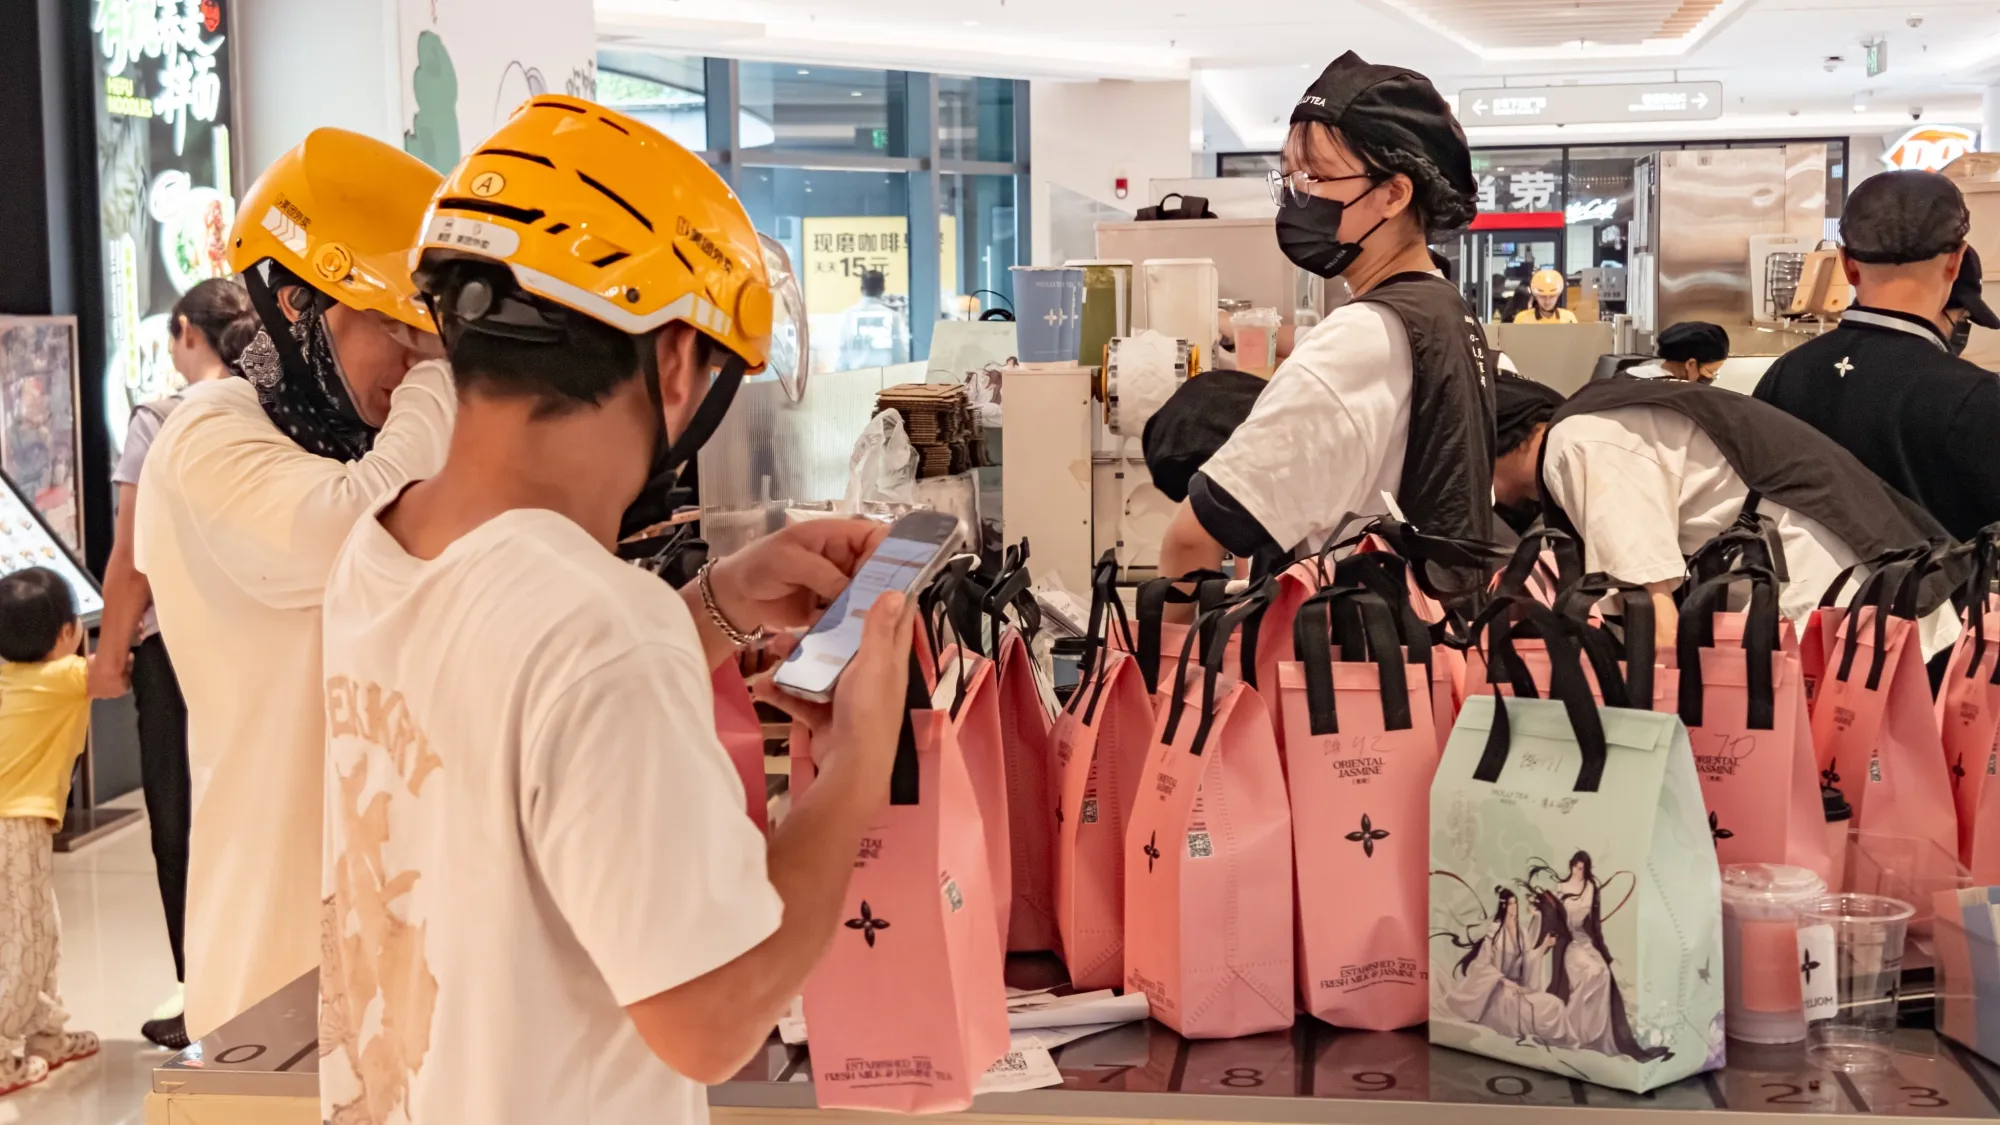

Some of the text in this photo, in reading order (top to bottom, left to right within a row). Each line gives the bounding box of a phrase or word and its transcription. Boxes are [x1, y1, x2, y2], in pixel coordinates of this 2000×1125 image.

[106, 77, 134, 97] HEFU
[106, 95, 153, 118] NOODLES
[1310, 96, 1326, 106] TEA
[476, 176, 494, 193] A
[813, 232, 944, 254] 现磨咖啡
[1333, 757, 1386, 770] ORIENTAL
[1339, 765, 1383, 778] JASMINE
[1694, 755, 1741, 767] RIENTAL
[1320, 978, 1349, 989] FRESH
[1380, 967, 1416, 979] JASMINE
[1094, 1063, 1137, 1084] 7
[1219, 1067, 1265, 1088] 8
[1351, 1071, 1397, 1092] 9
[1760, 1083, 1812, 1105] 2
[1900, 1086, 1950, 1107] 3
